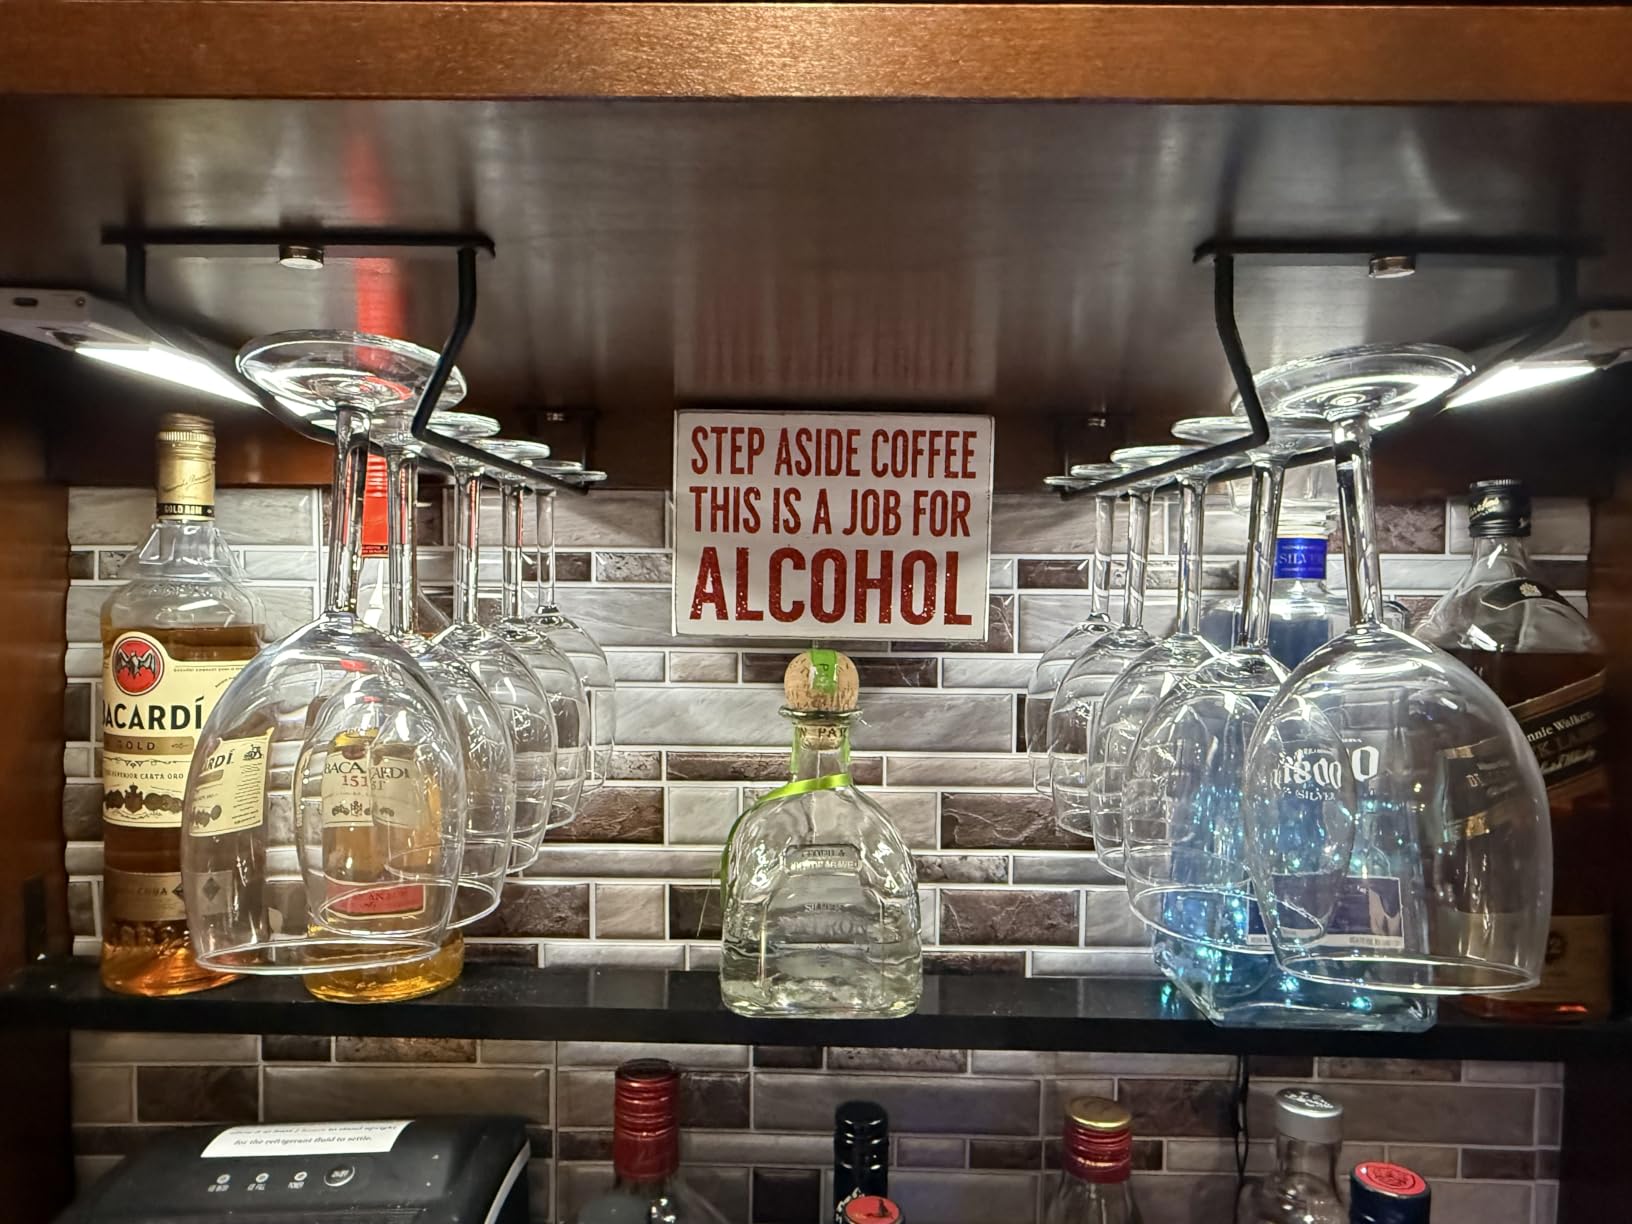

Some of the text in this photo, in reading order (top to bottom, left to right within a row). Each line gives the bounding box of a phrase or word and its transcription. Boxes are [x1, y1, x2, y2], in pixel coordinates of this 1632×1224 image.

[690, 426, 977, 479] STEP ASIDE COFFEE
[689, 486, 971, 537] THIS IS A JOB FOR
[689, 546, 973, 626] ALCOHOL
